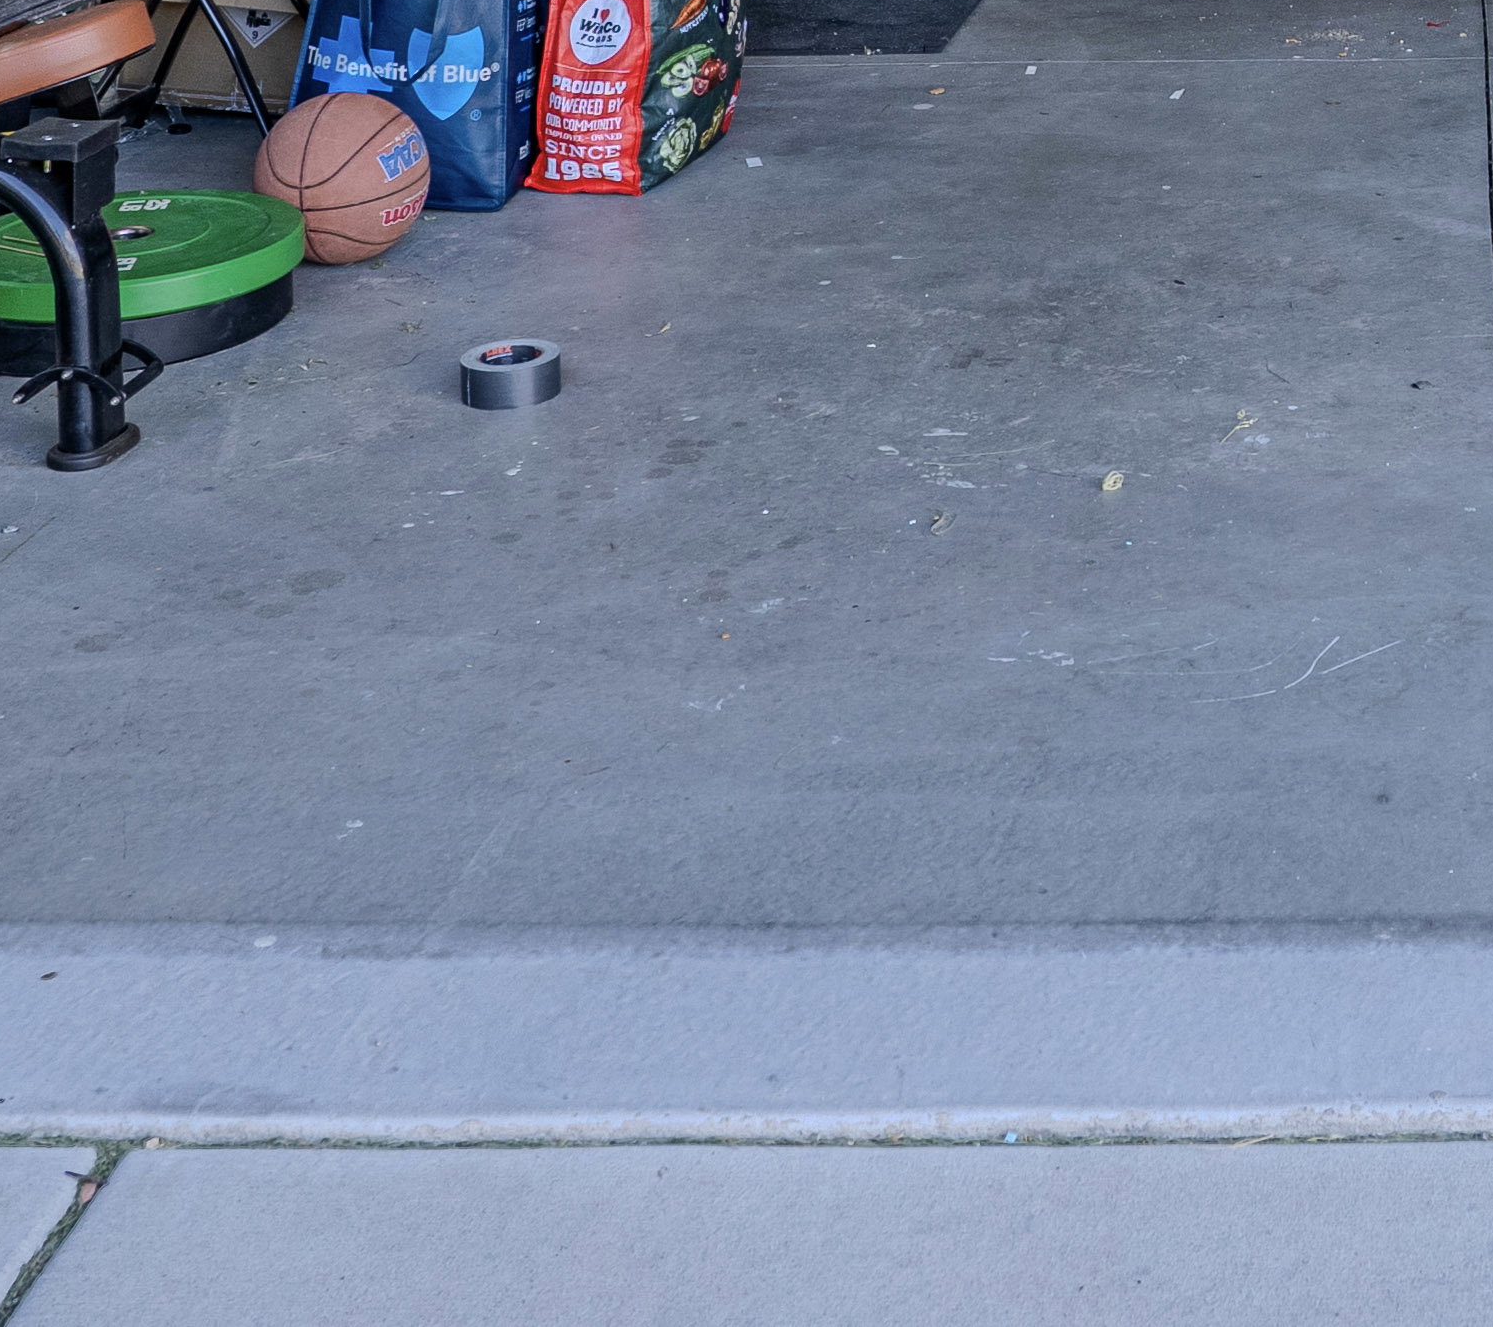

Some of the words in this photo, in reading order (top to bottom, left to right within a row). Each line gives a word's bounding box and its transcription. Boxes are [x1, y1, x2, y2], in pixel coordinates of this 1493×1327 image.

[307, 45, 331, 71] The
[335, 53, 408, 82] Benefit
[552, 74, 627, 95] PROUDLY
[549, 97, 604, 116] POWERED
[607, 96, 625, 113] BY
[545, 114, 561, 130] OUR
[562, 116, 623, 131] COMMUNITY
[545, 142, 622, 159] SINCE
[543, 157, 623, 182] 1985
